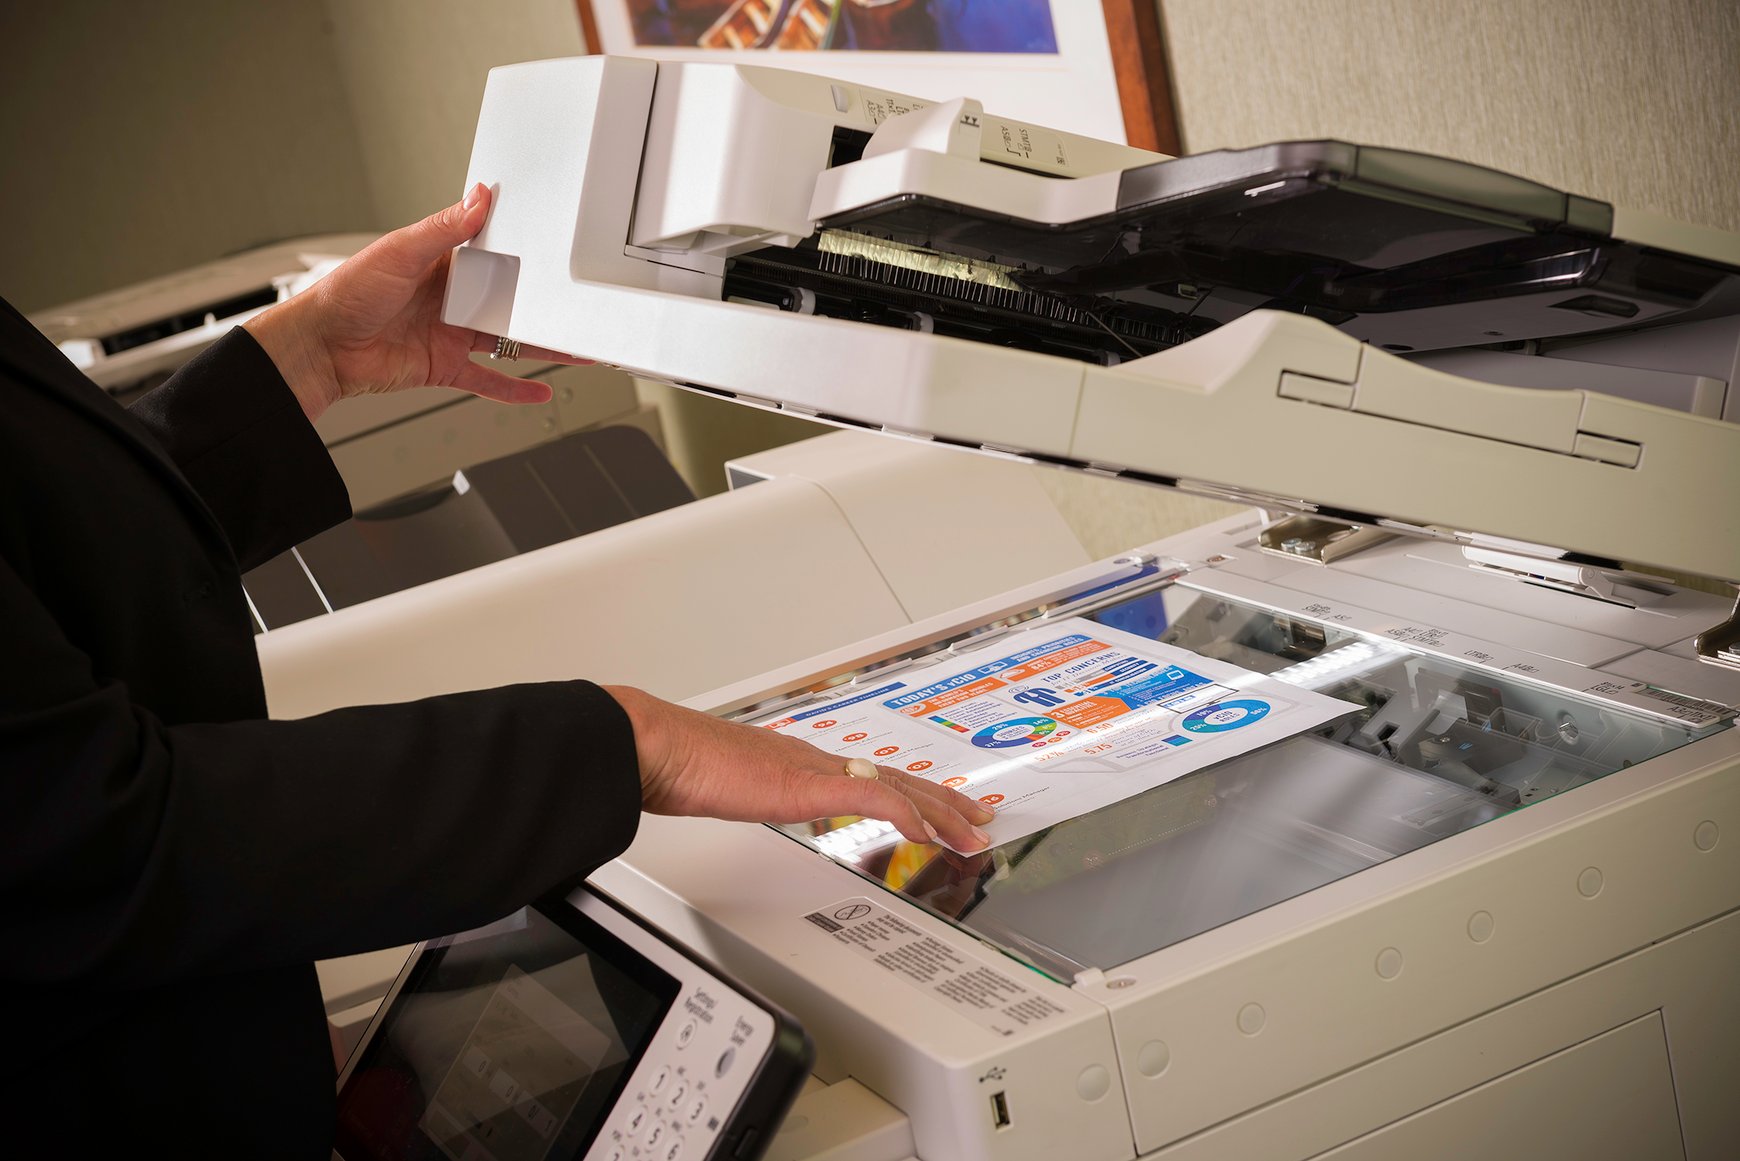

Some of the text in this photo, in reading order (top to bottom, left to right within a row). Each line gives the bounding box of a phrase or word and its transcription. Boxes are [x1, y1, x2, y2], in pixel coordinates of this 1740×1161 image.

[1041, 672, 1064, 683] TOP
[1063, 651, 1121, 674] CONCERNS
[892, 673, 976, 706] TODAY'S vCIO
[1084, 742, 1112, 755] 5.75
